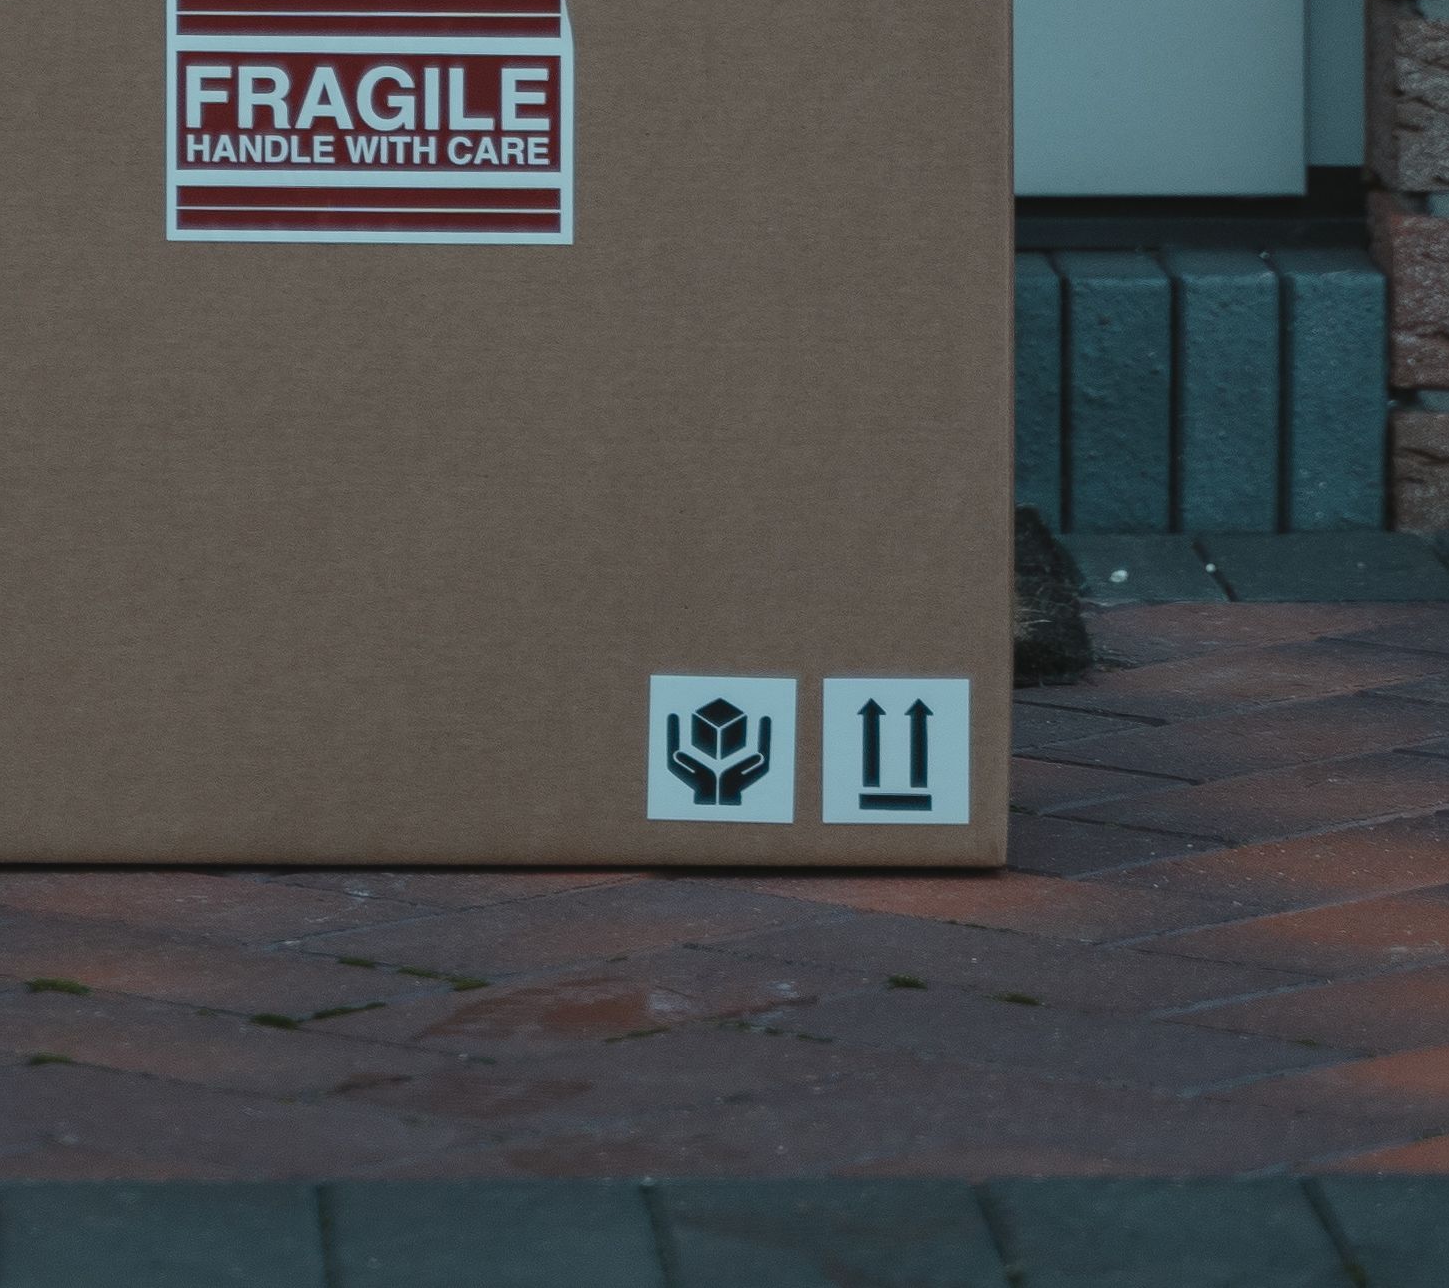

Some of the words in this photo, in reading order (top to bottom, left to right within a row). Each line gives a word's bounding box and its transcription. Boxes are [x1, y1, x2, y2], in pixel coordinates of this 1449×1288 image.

[185, 65, 551, 131] FRAGILE
[186, 134, 336, 164] HANDLE
[344, 135, 438, 165] WITH
[446, 136, 550, 166] CARE
